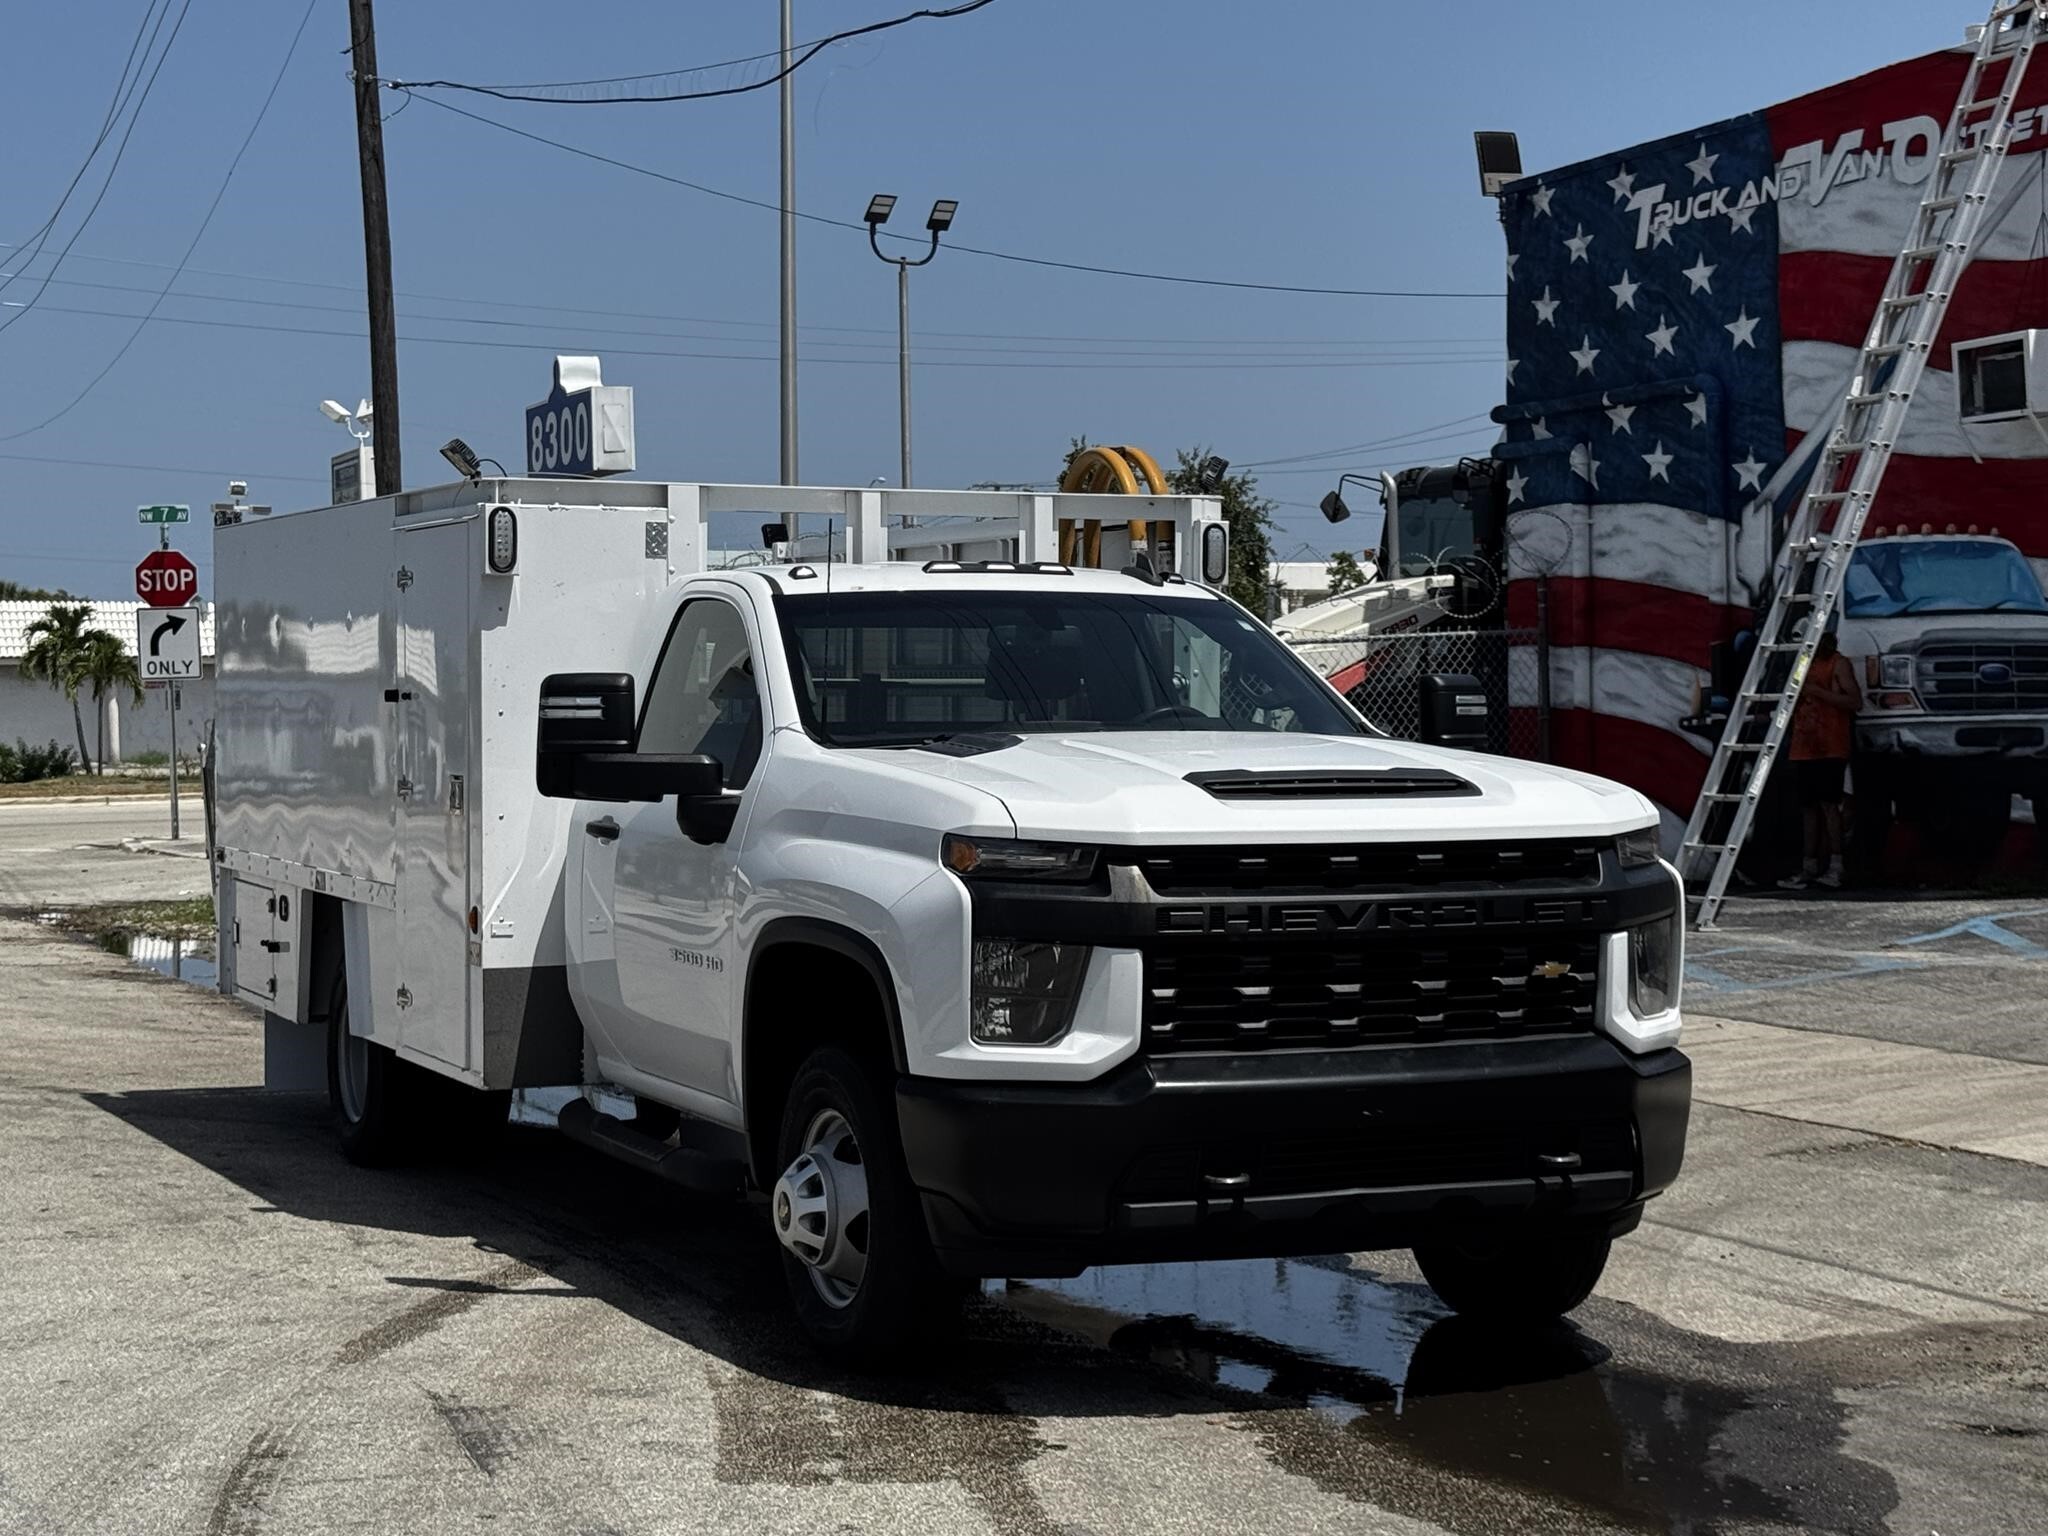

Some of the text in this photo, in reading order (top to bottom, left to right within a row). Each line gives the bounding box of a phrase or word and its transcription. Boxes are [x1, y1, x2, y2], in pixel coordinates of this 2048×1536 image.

[1624, 183, 1731, 250] TRUCK
[1735, 173, 1800, 210] AND
[1779, 128, 1884, 208] VAN
[531, 402, 588, 472] 8300
[140, 507, 188, 521] NW 7 AV
[139, 568, 194, 592] STOP
[147, 659, 193, 676] ONLY
[1155, 896, 1608, 934] CHEVROLET
